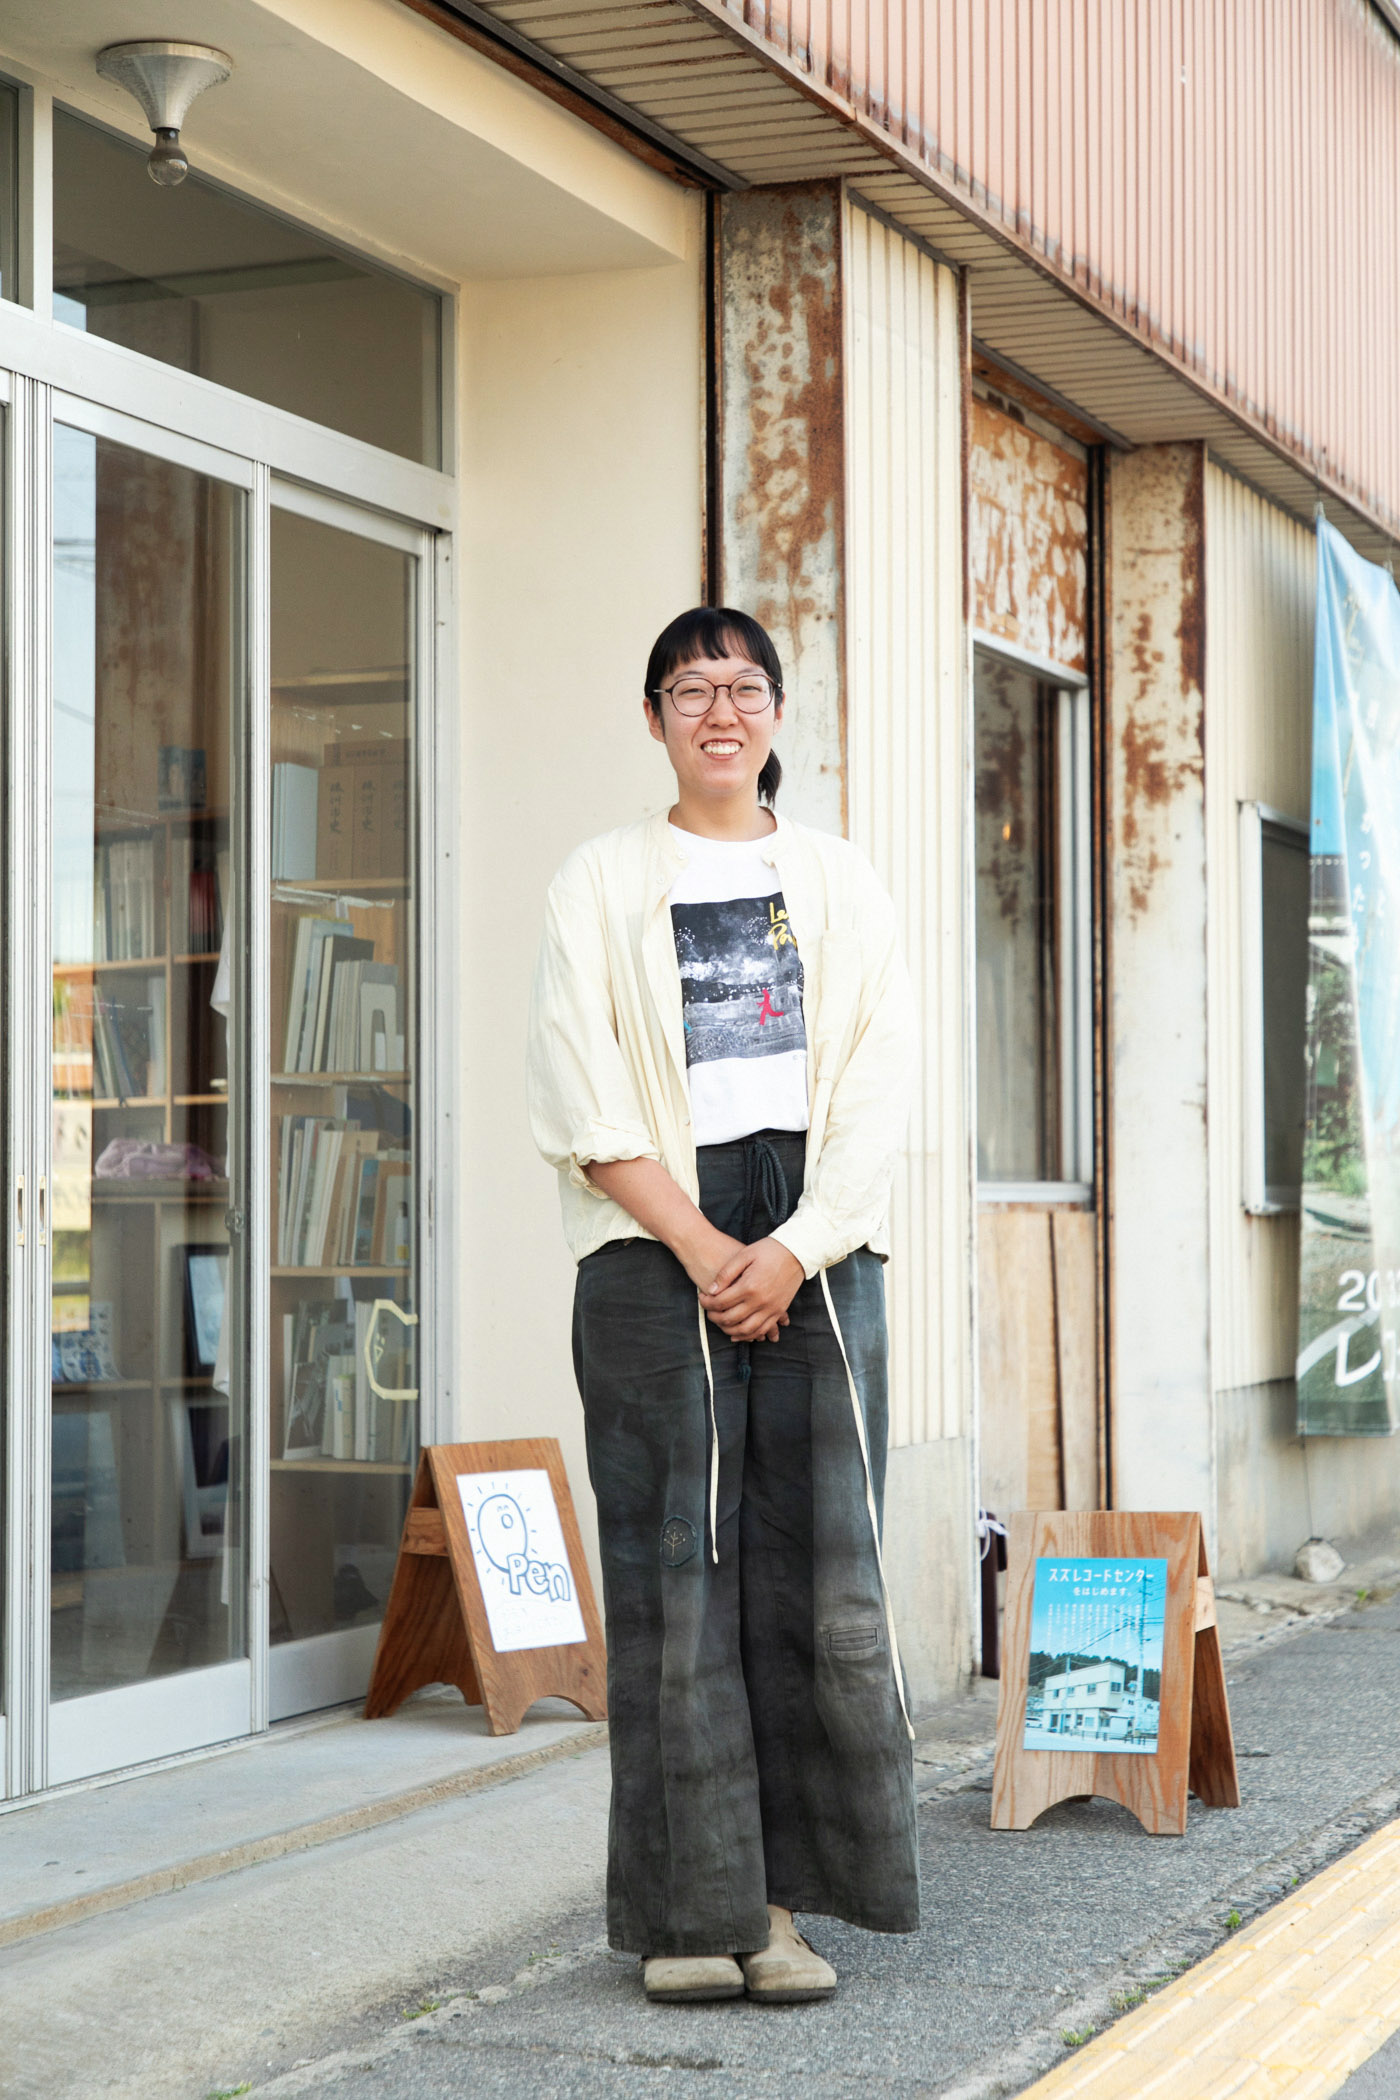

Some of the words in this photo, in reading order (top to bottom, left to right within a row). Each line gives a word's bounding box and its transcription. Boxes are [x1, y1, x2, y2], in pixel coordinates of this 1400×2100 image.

[1048, 1568, 1154, 1583] スズレコードセンター
[1073, 1587, 1132, 1597] をはじめます。
